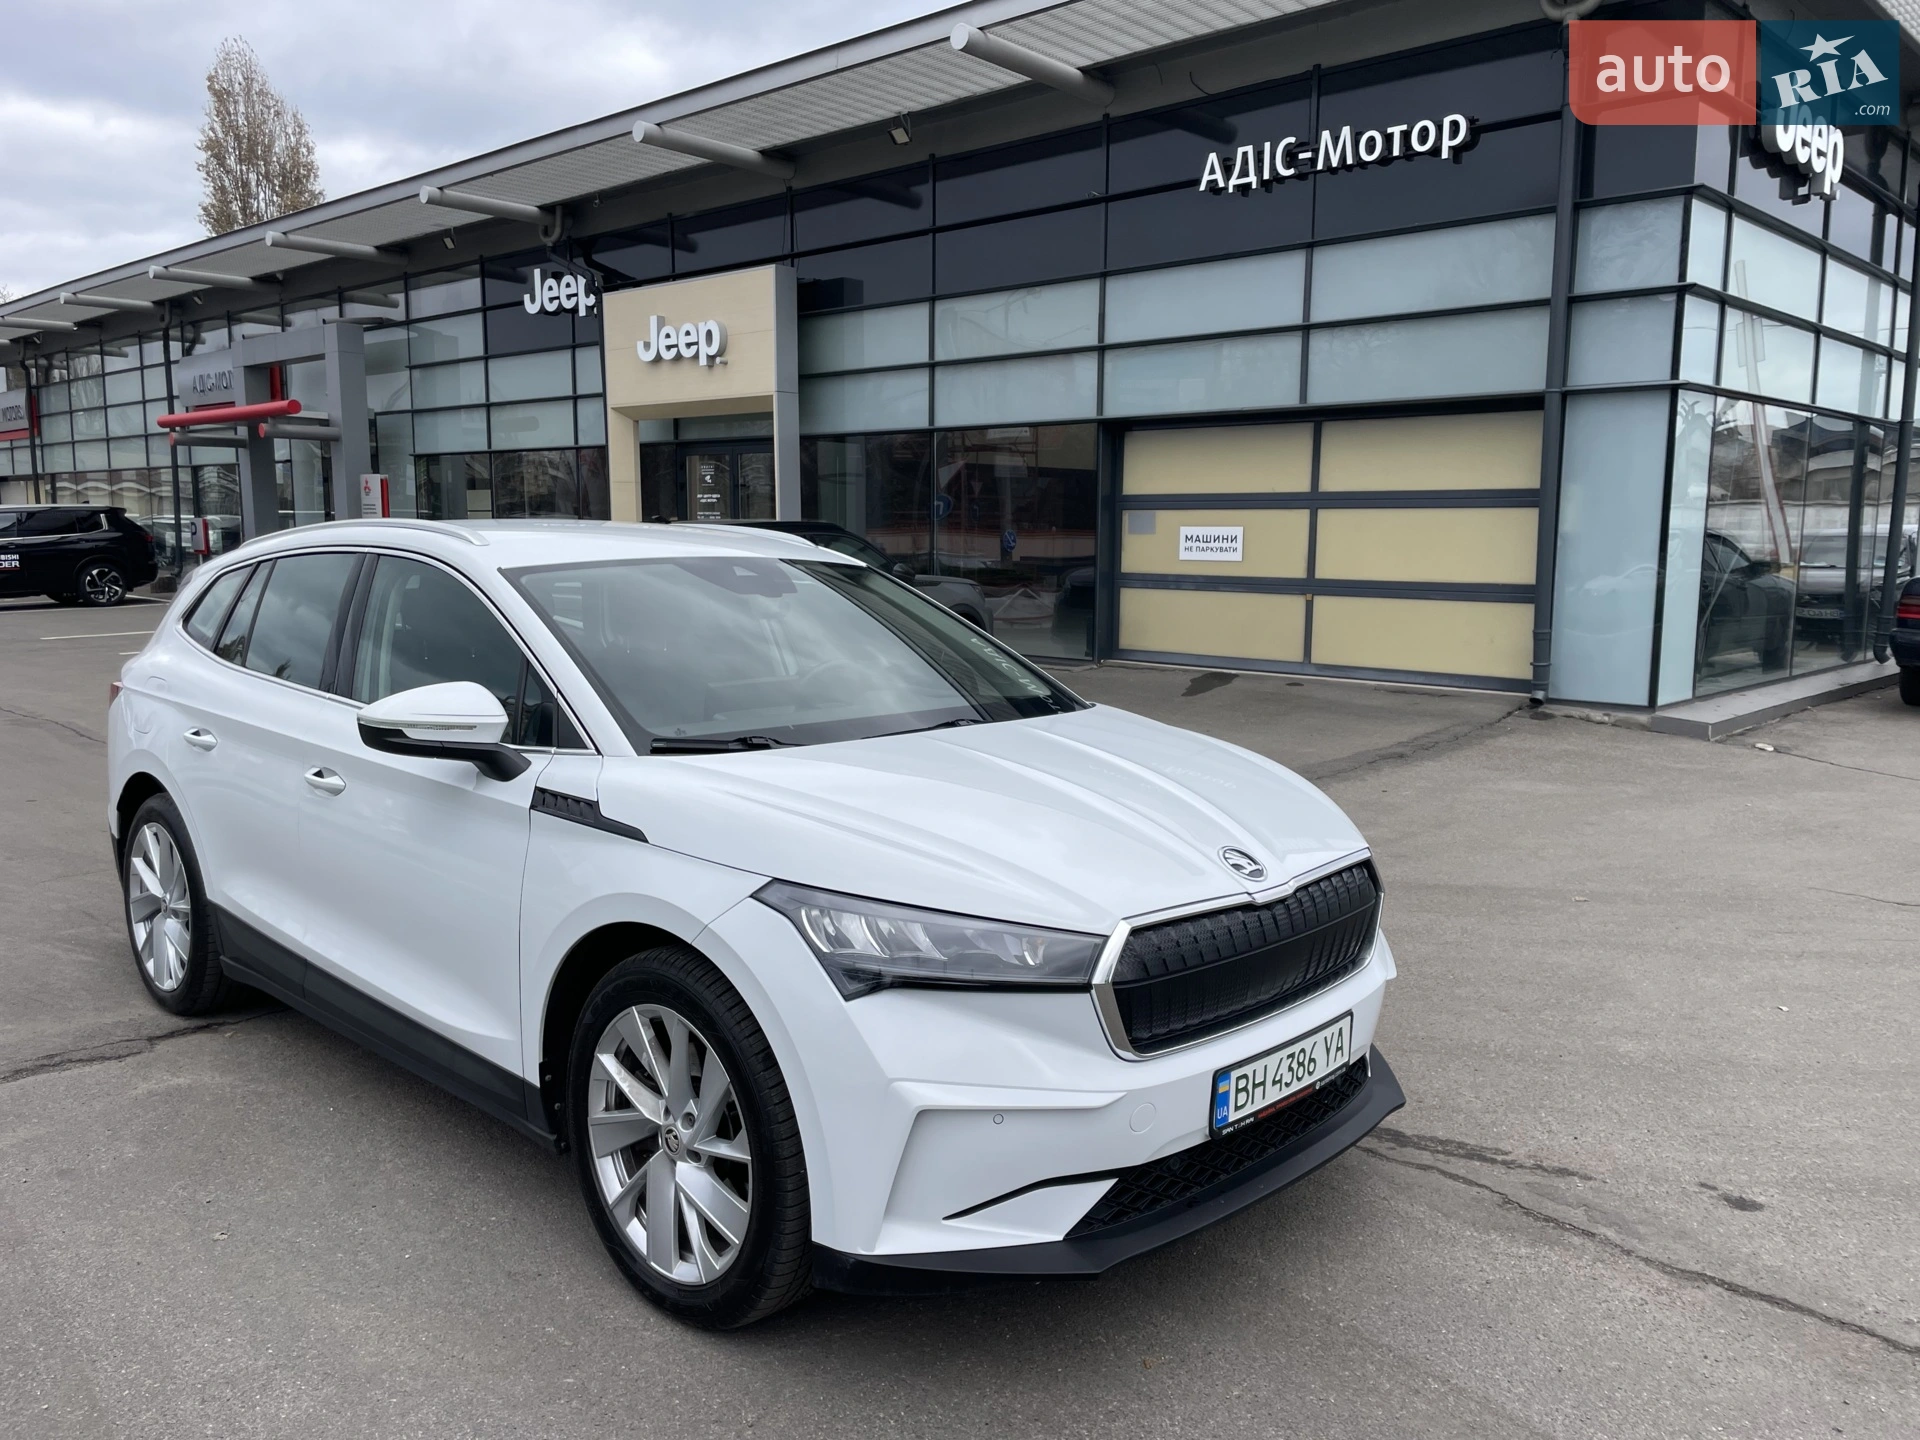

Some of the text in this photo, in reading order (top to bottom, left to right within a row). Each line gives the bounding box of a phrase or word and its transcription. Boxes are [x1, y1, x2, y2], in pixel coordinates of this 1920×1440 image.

[1198, 113, 1468, 194] АДІС-Мотор
[523, 267, 598, 317] Jeep
[636, 314, 721, 367] Jeep
[1184, 534, 1238, 544] МАШИНИ
[1184, 545, 1238, 553] НЕ ПАРКУВАТИ
[1233, 1064, 1268, 1113] BH
[1271, 1041, 1317, 1093] 4386
[1324, 1026, 1345, 1068] YA
[1217, 1106, 1229, 1120] UA
